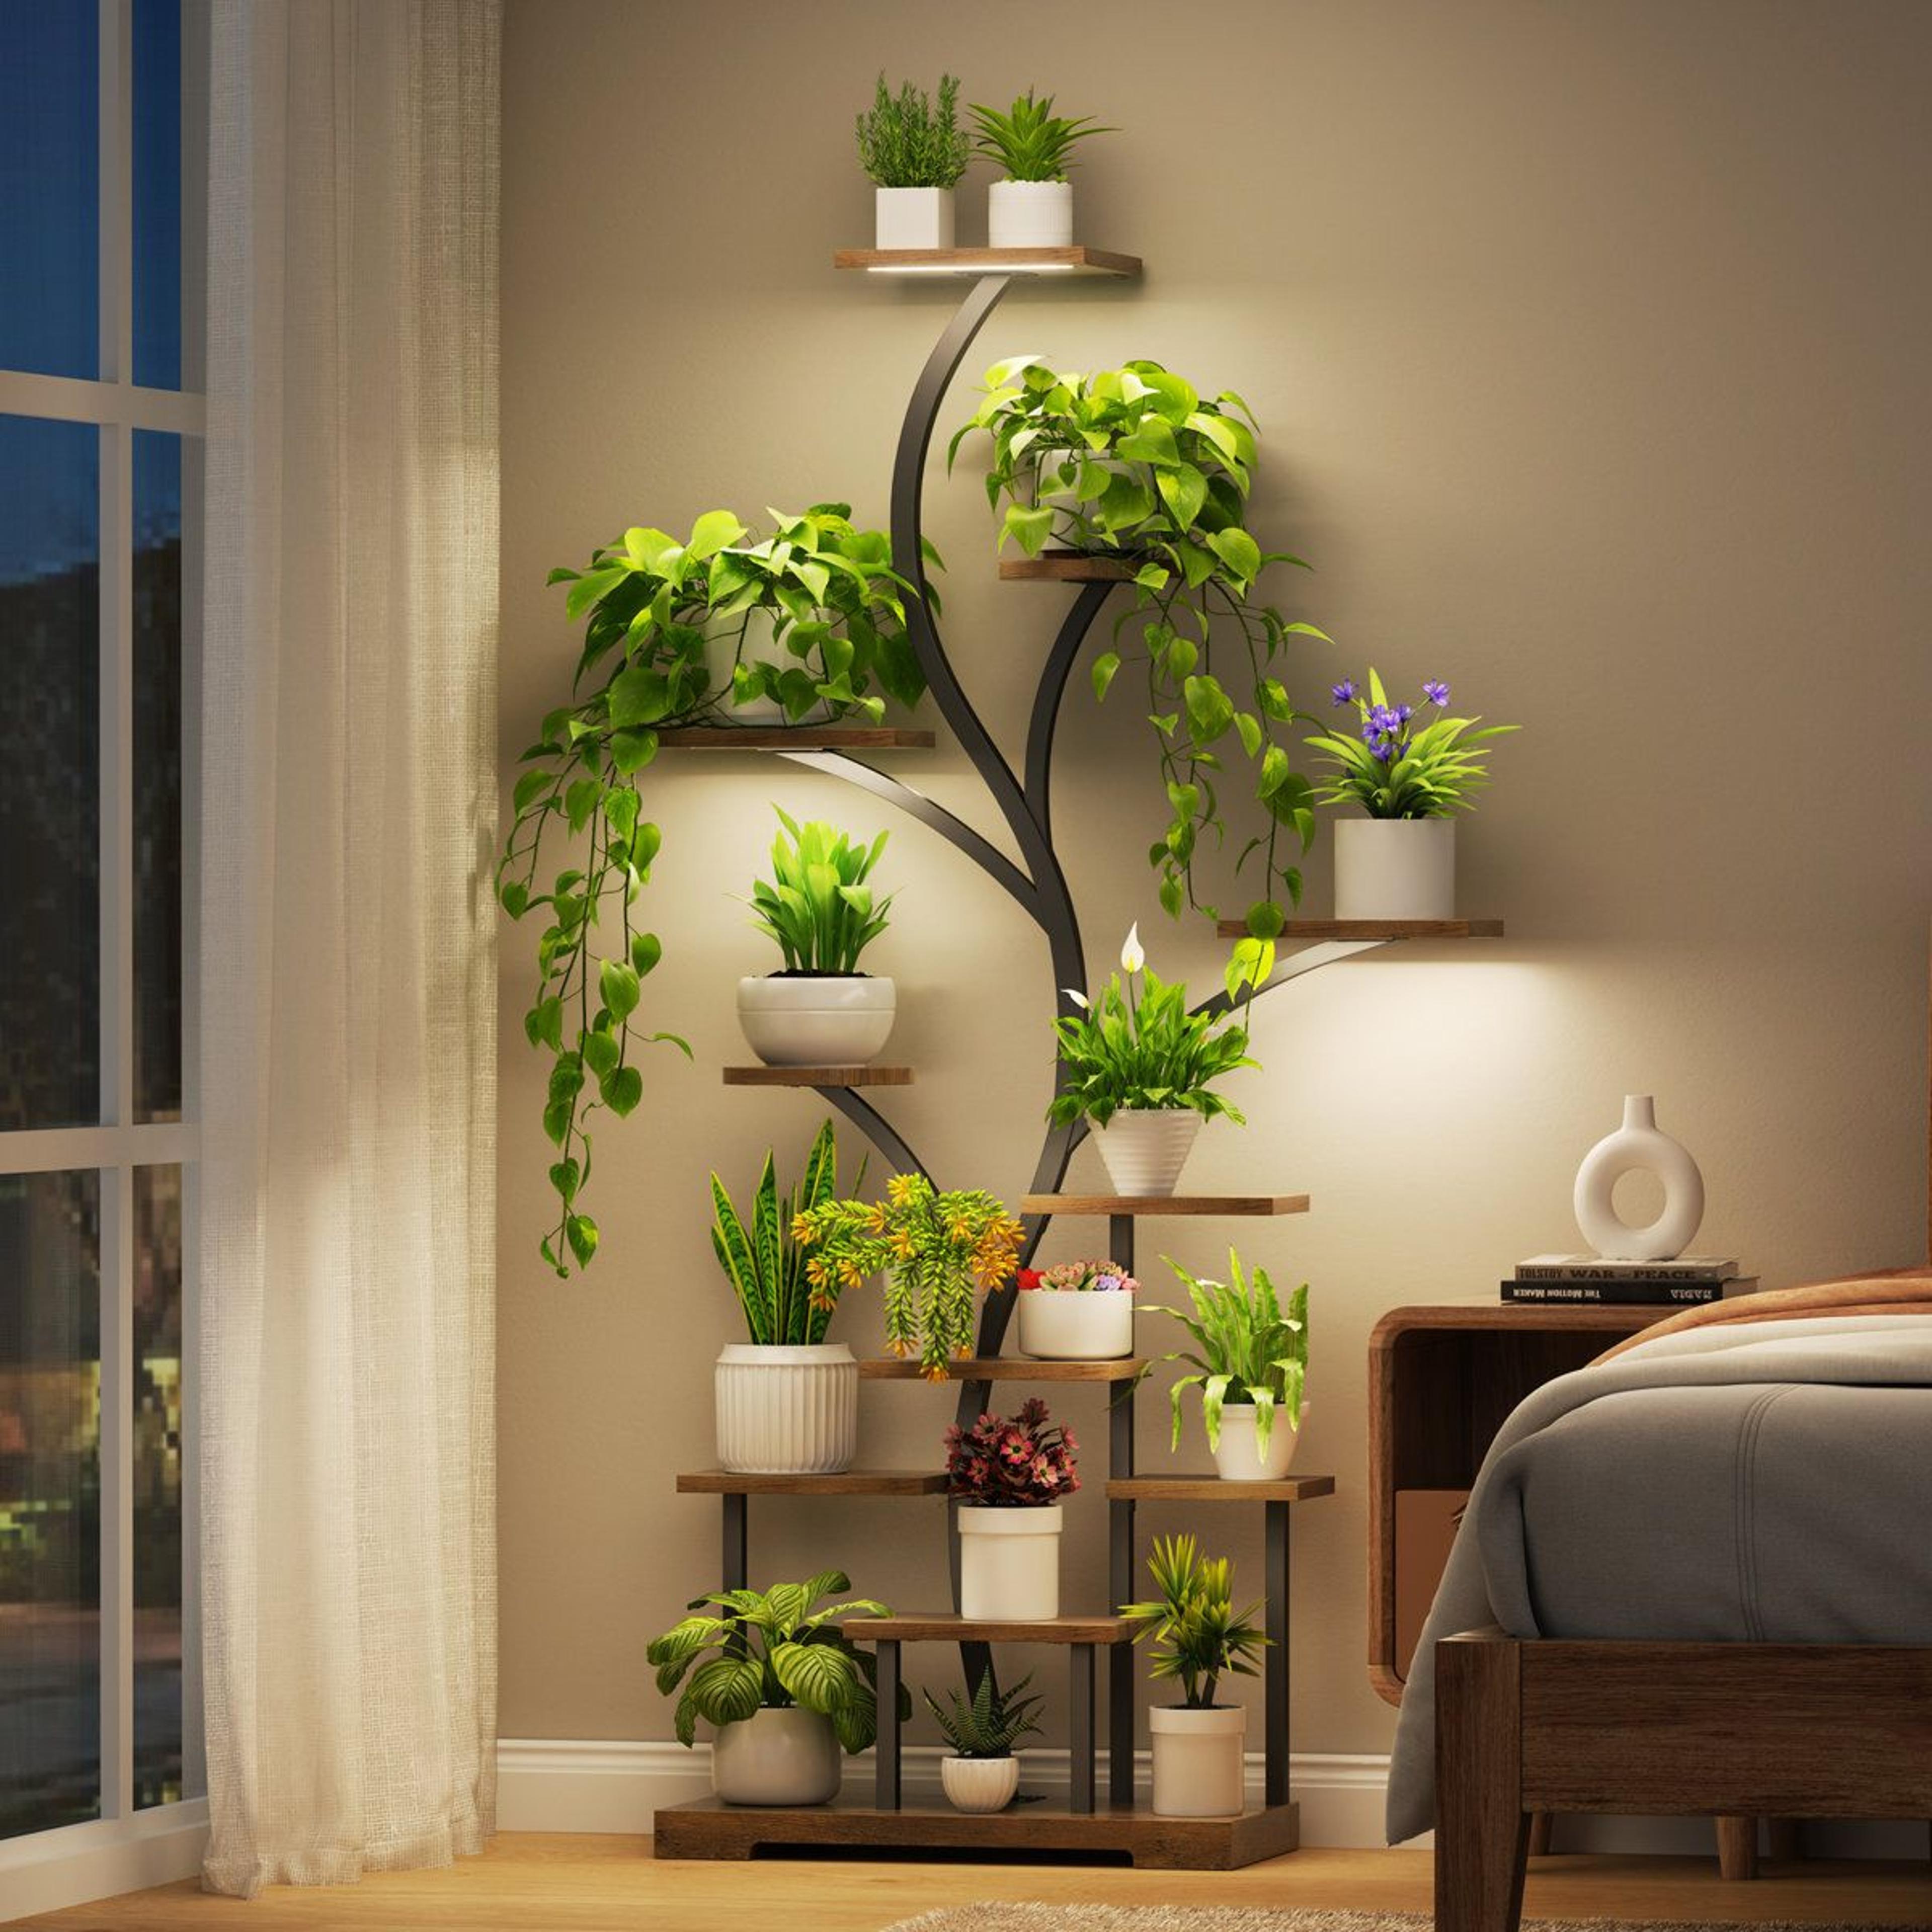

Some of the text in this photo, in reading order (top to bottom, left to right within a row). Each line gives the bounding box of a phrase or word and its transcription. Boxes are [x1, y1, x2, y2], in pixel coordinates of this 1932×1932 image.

[1519, 1268, 1563, 1278] TOLSTOY
[1570, 1269, 1615, 1278] WAR
[1634, 1270, 1697, 1279] PEACE
[1547, 1289, 1582, 1298] MOTION
